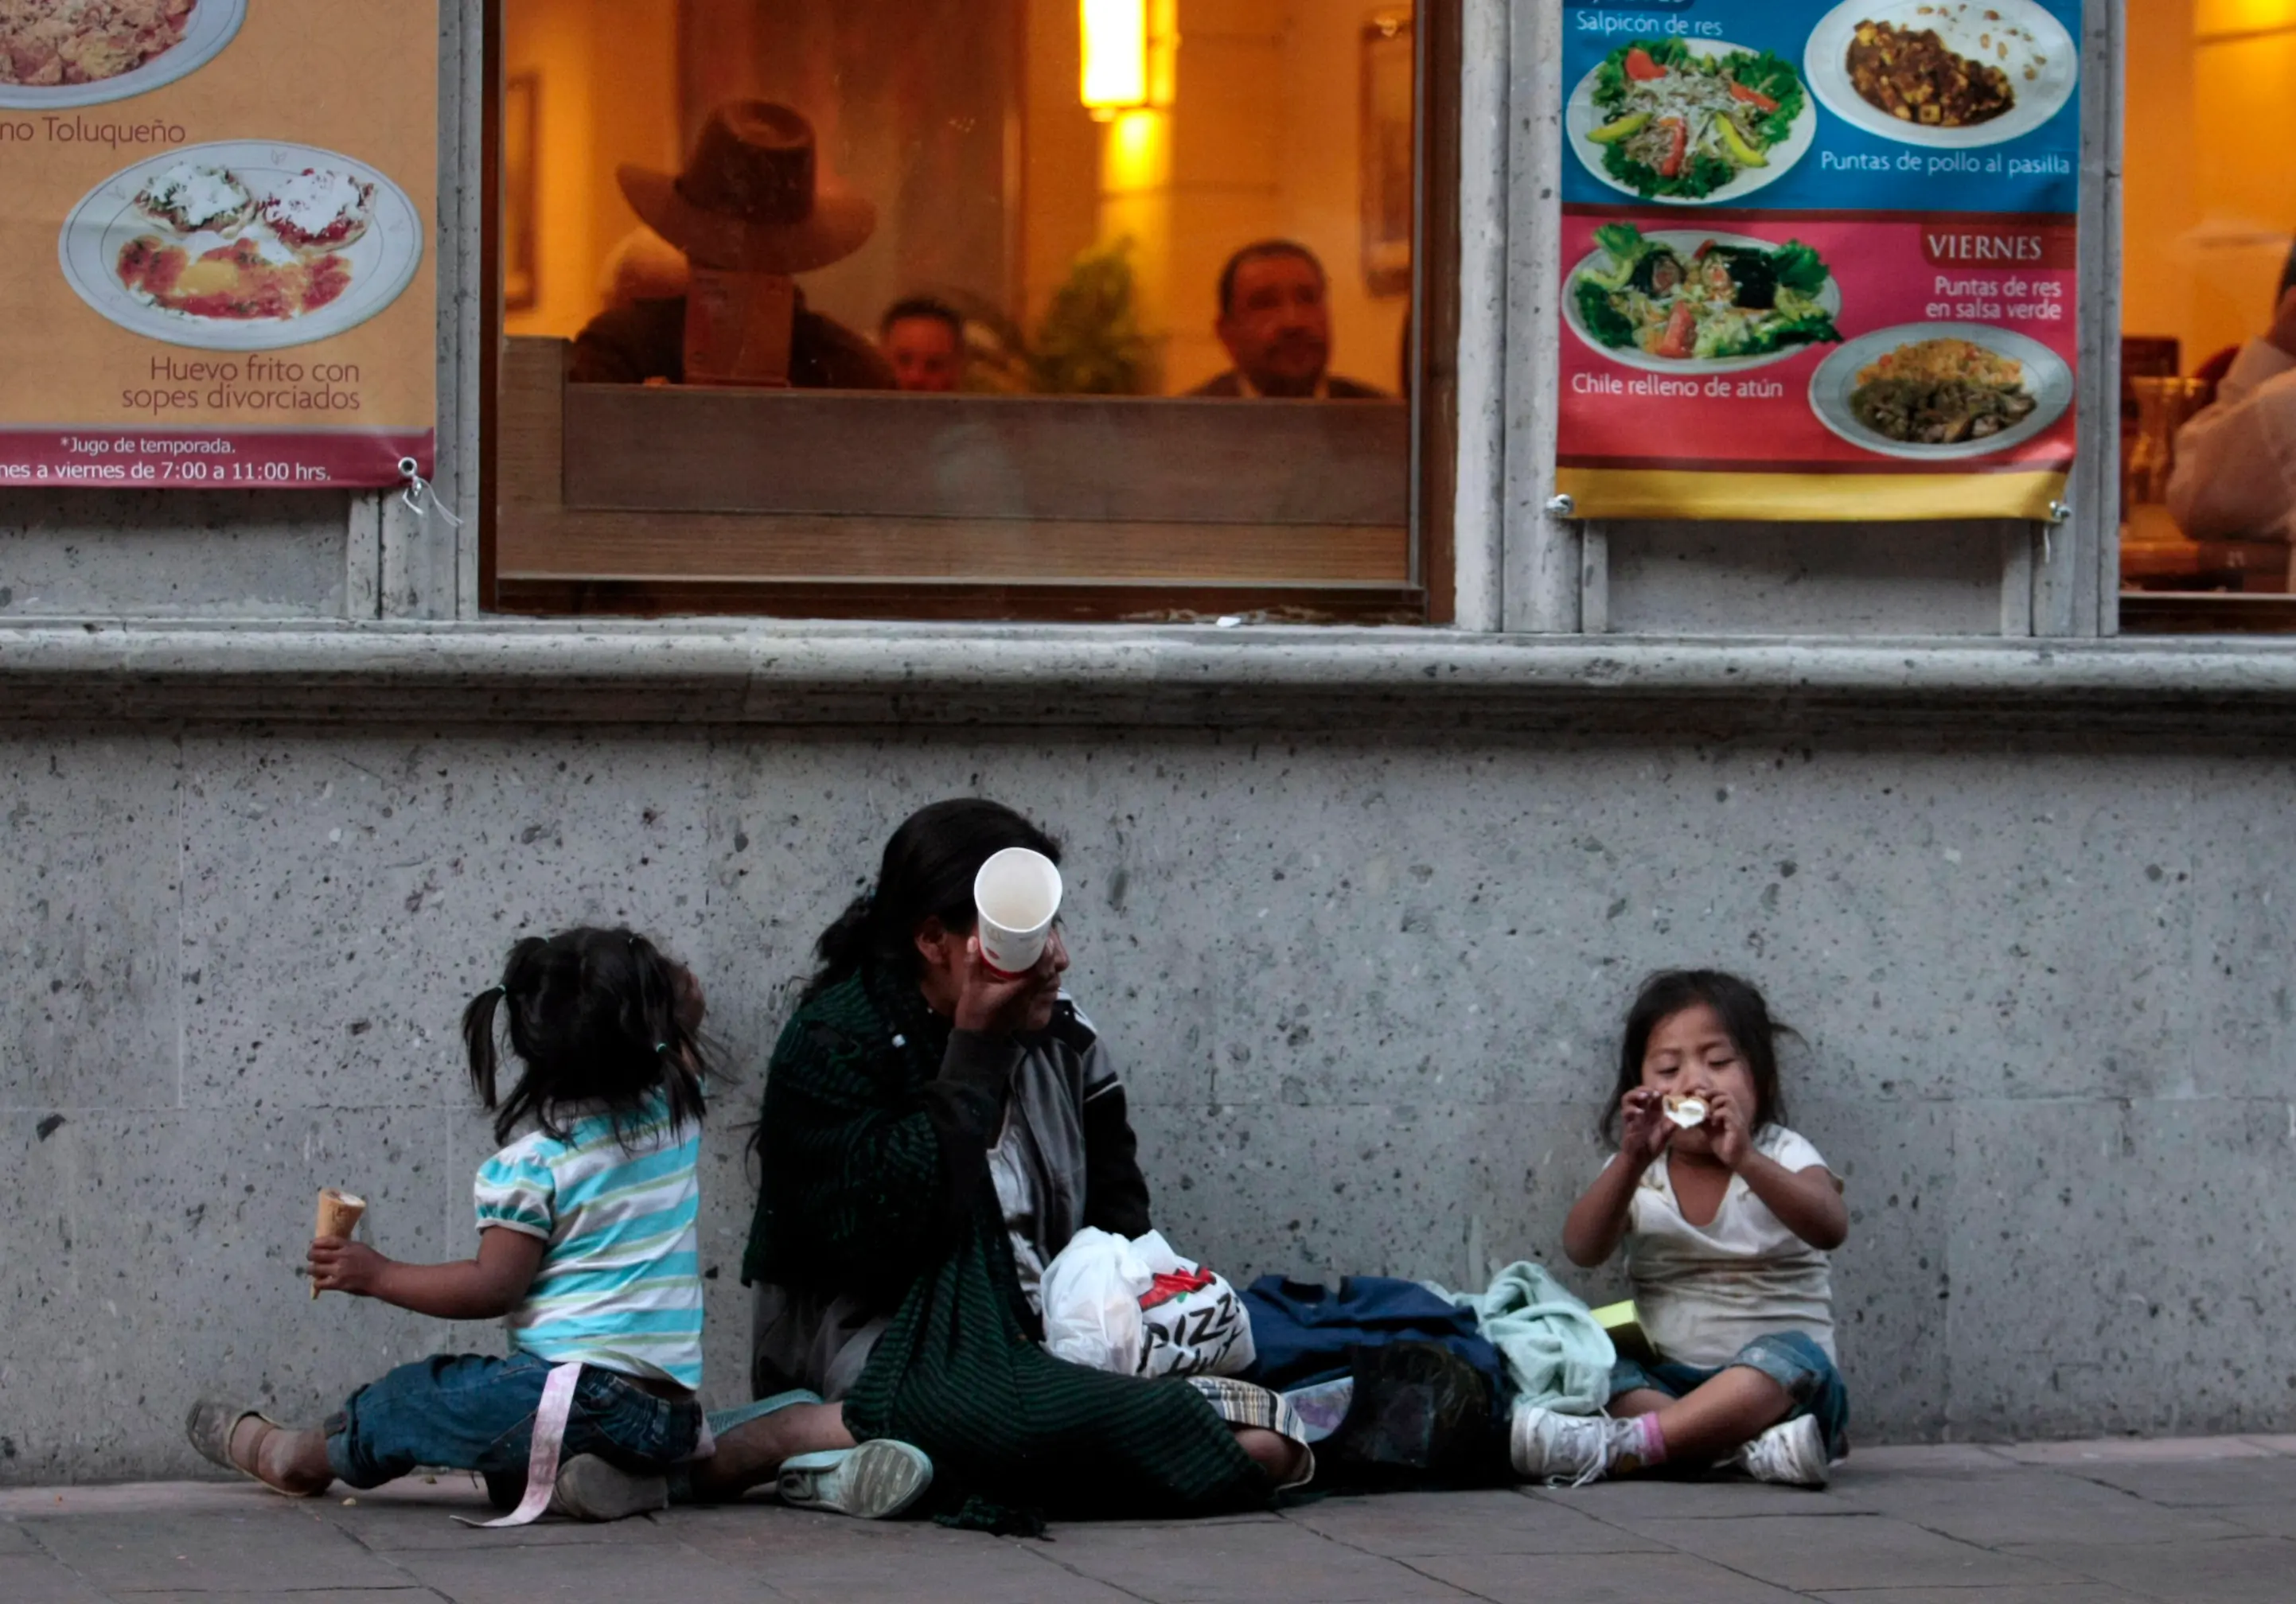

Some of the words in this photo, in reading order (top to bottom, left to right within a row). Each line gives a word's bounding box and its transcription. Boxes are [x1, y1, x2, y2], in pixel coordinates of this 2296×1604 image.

[1577, 10, 1659, 37] Salpicón
[1665, 13, 1690, 34] de
[1694, 21, 1724, 37] res
[41, 115, 186, 150] Toluqueño
[1821, 150, 1891, 170] Puntas
[1896, 150, 1922, 171] de
[1928, 151, 1981, 176] pollo
[1985, 153, 2002, 173] al
[2009, 154, 2070, 179] pasilla
[1928, 234, 2043, 260] VIERNES
[1935, 275, 1998, 298] Puntas
[2002, 275, 2028, 298] de
[2032, 281, 2063, 298] res
[1925, 302, 1951, 319] en
[1955, 298, 2002, 319] salsa
[2006, 299, 2062, 321] verde
[150, 356, 238, 382] Huevo
[246, 353, 304, 382] frito
[312, 363, 360, 383] con
[1571, 372, 1623, 395] Chile
[1627, 374, 1699, 397] relleno
[1703, 376, 1732, 398] de
[1736, 377, 1783, 398] atún
[122, 389, 198, 416] sopes
[207, 382, 361, 410] divorciados
[114, 437, 135, 454] de
[140, 438, 236, 457] temporada.
[37, 463, 48, 478] a
[55, 461, 125, 479] viernes
[131, 461, 155, 479] de
[161, 461, 207, 480] 7:00
[212, 465, 225, 480] a
[232, 462, 290, 481] 11:00
[295, 462, 331, 481] hrs.
